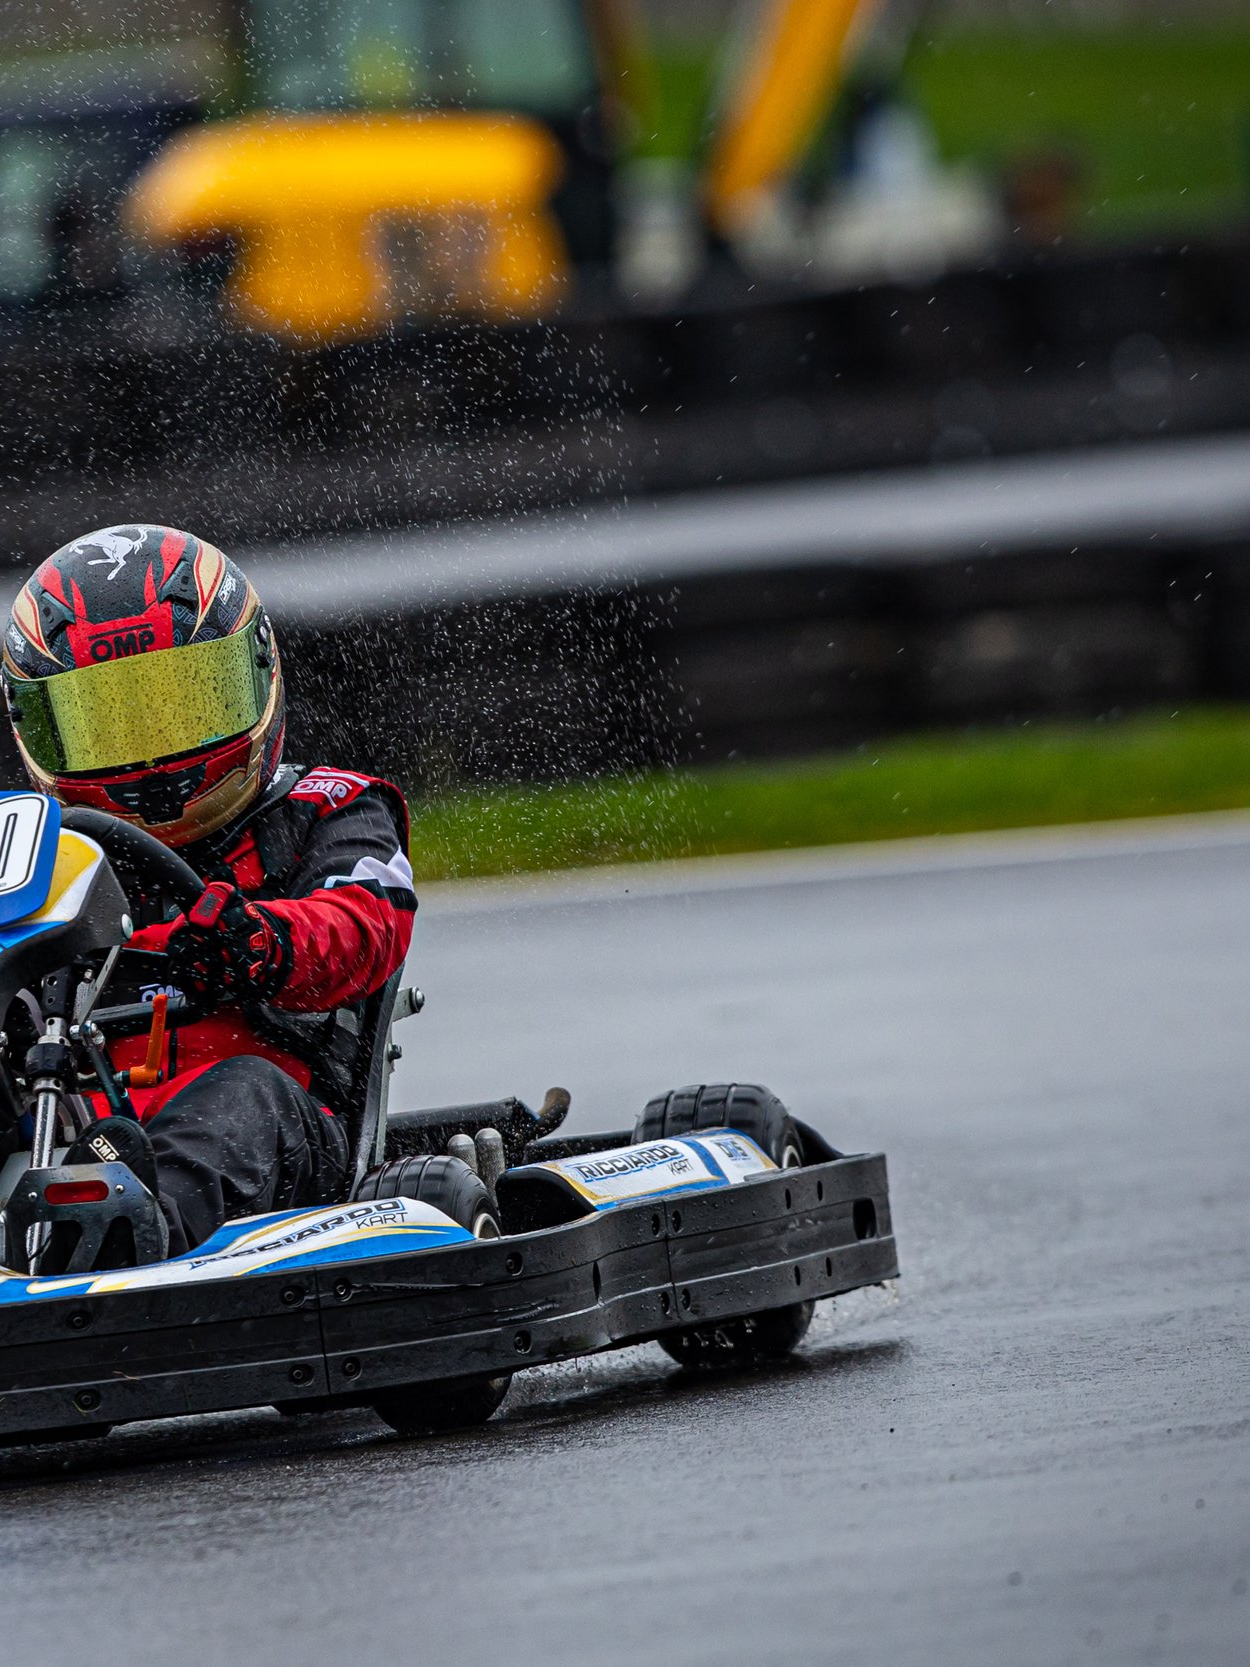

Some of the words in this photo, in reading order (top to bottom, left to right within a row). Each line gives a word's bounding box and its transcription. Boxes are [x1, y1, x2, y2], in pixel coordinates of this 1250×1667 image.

[90, 628, 156, 662] OMP
[294, 780, 348, 799] OMP
[92, 1137, 117, 1161] OMP
[572, 1145, 684, 1181] RICCIARDO
[667, 1158, 693, 1176] KART
[356, 1212, 408, 1230] KART
